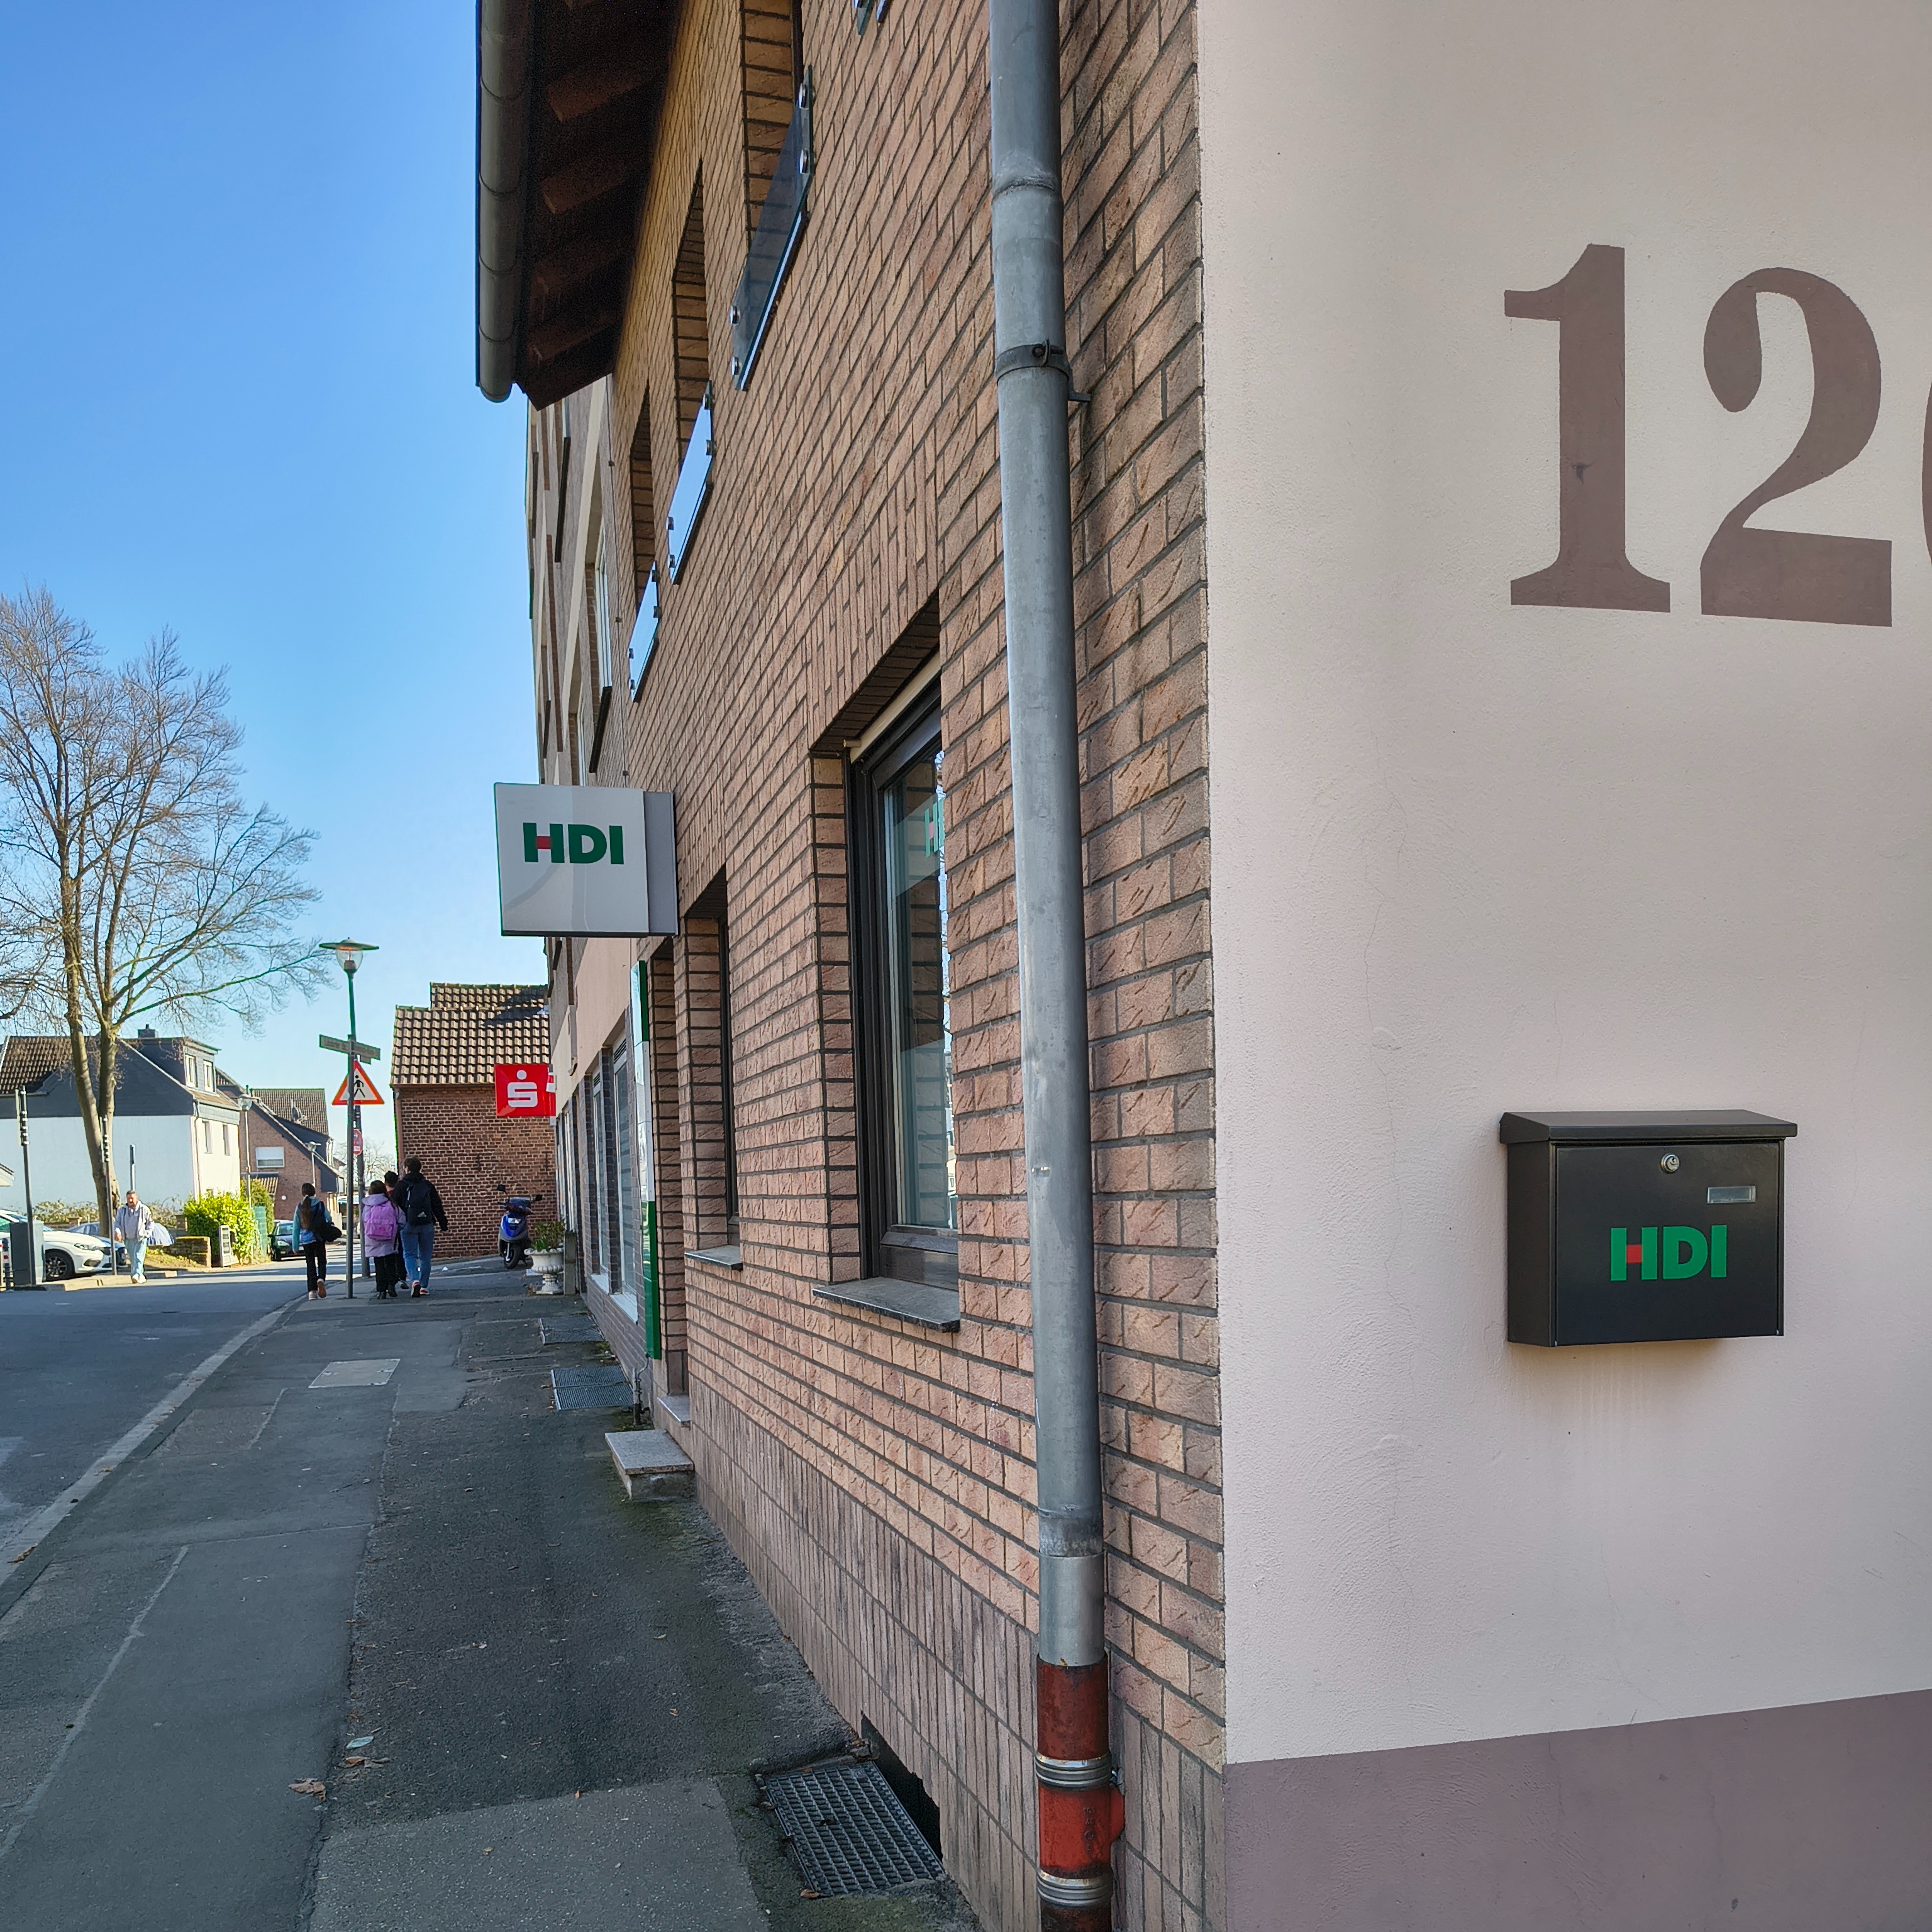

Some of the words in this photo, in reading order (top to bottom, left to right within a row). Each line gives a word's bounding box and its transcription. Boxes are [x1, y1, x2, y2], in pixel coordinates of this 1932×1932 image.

[1504, 243, 1932, 627] 12
[523, 822, 624, 865] HDI
[1610, 1224, 1728, 1282] HDI
